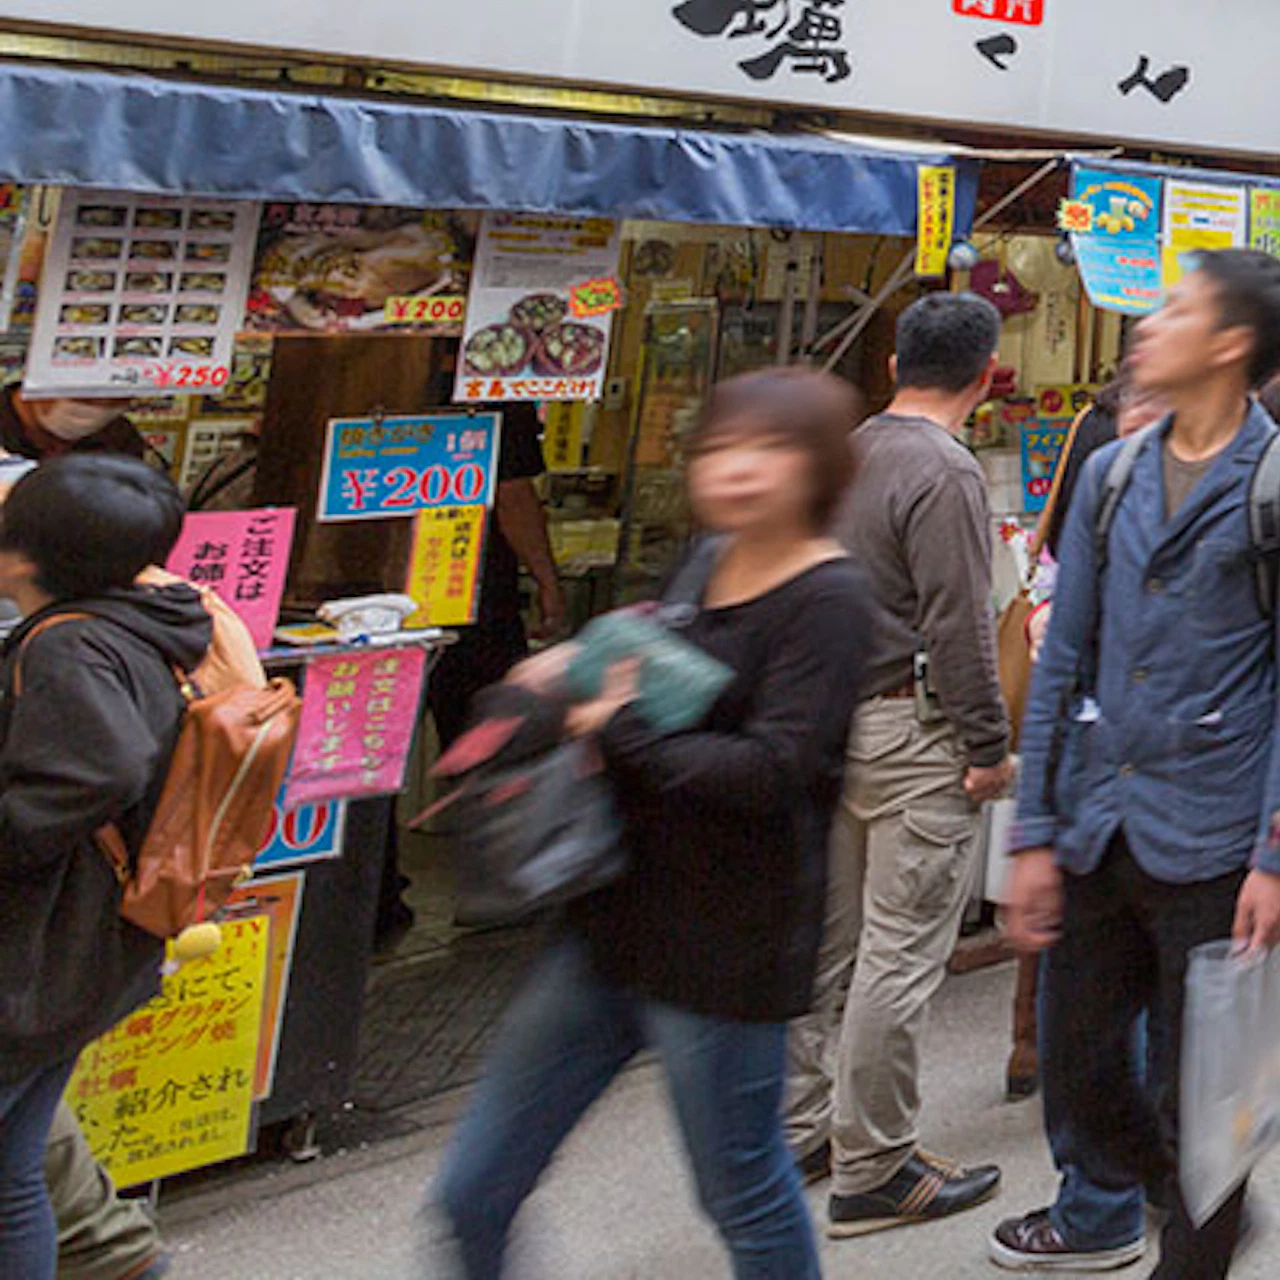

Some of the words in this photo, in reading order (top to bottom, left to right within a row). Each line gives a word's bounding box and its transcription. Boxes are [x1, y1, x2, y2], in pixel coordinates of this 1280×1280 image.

[391, 299, 463, 321] ¥200
[153, 364, 230, 388] ¥250
[341, 463, 486, 511] ¥200
[189, 541, 229, 593] お姉
[236, 515, 279, 601] ご注文は
[321, 662, 359, 771] お願いします
